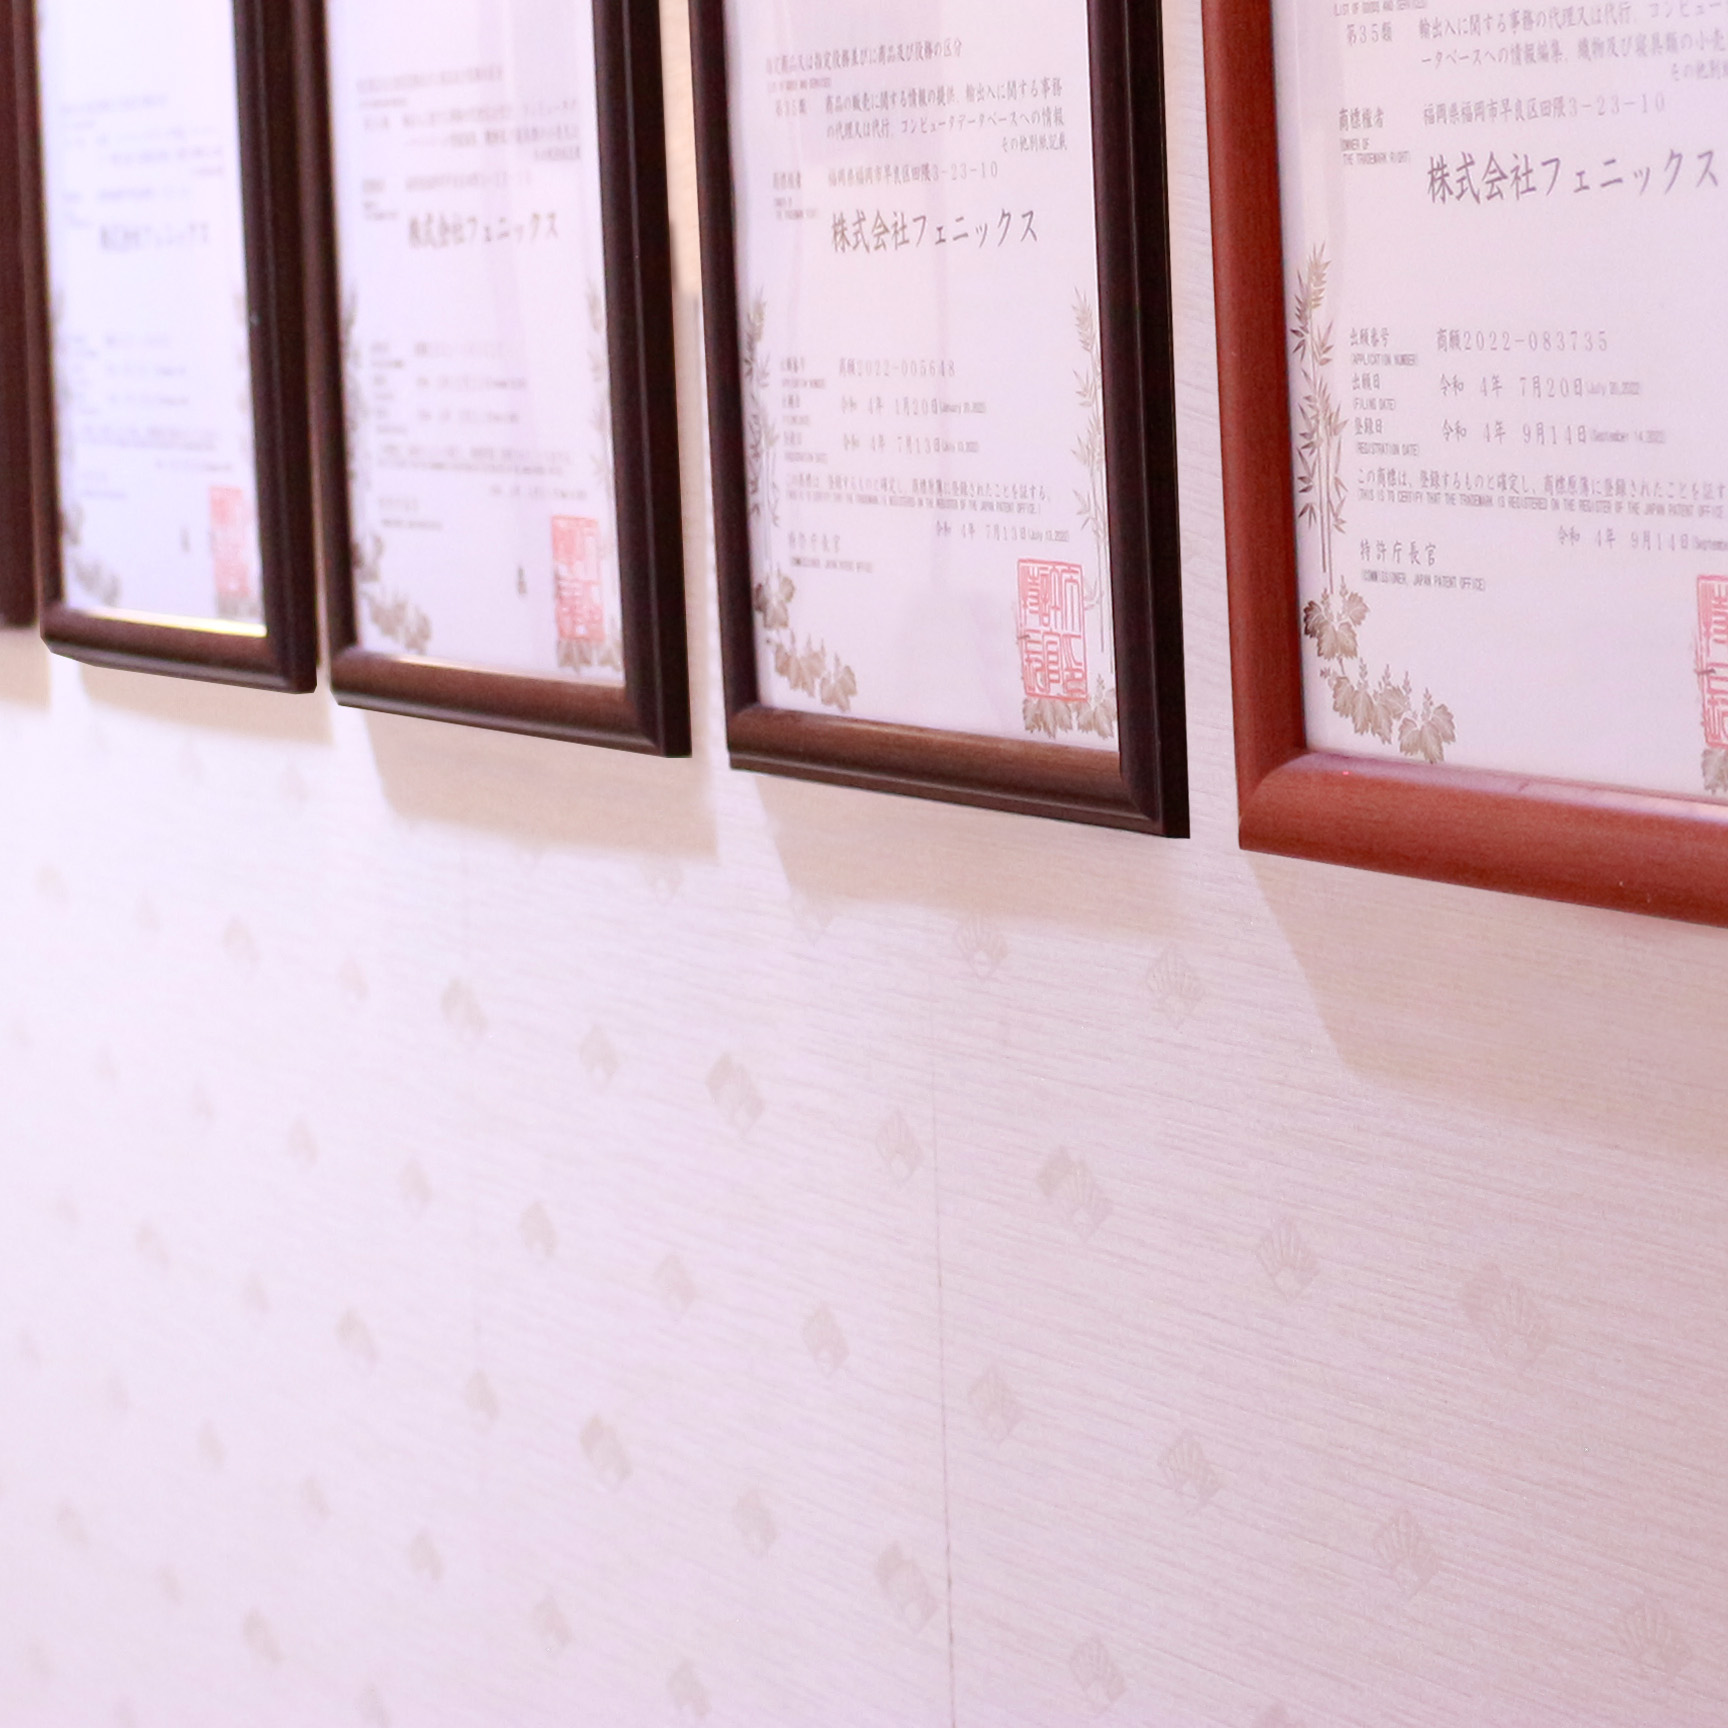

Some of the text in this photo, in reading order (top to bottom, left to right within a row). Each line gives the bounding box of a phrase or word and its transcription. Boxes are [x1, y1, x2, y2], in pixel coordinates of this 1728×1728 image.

[1346, 20, 1393, 47] 第35類
[1338, 106, 1385, 132] 商標権者
[1426, 147, 1719, 206] 株式会社フェニックス
[830, 207, 1039, 254] 株式会社フェニックス
[1349, 326, 1608, 352] 出願番号 商願2022-083735
[1352, 372, 1381, 391] 出願日
[1440, 373, 1465, 397] 令和
[1354, 417, 1383, 436] 登録日
[1442, 418, 1467, 443] 令和
[1556, 524, 1581, 547] 令和
[1360, 538, 1437, 567] 特許庁長官
